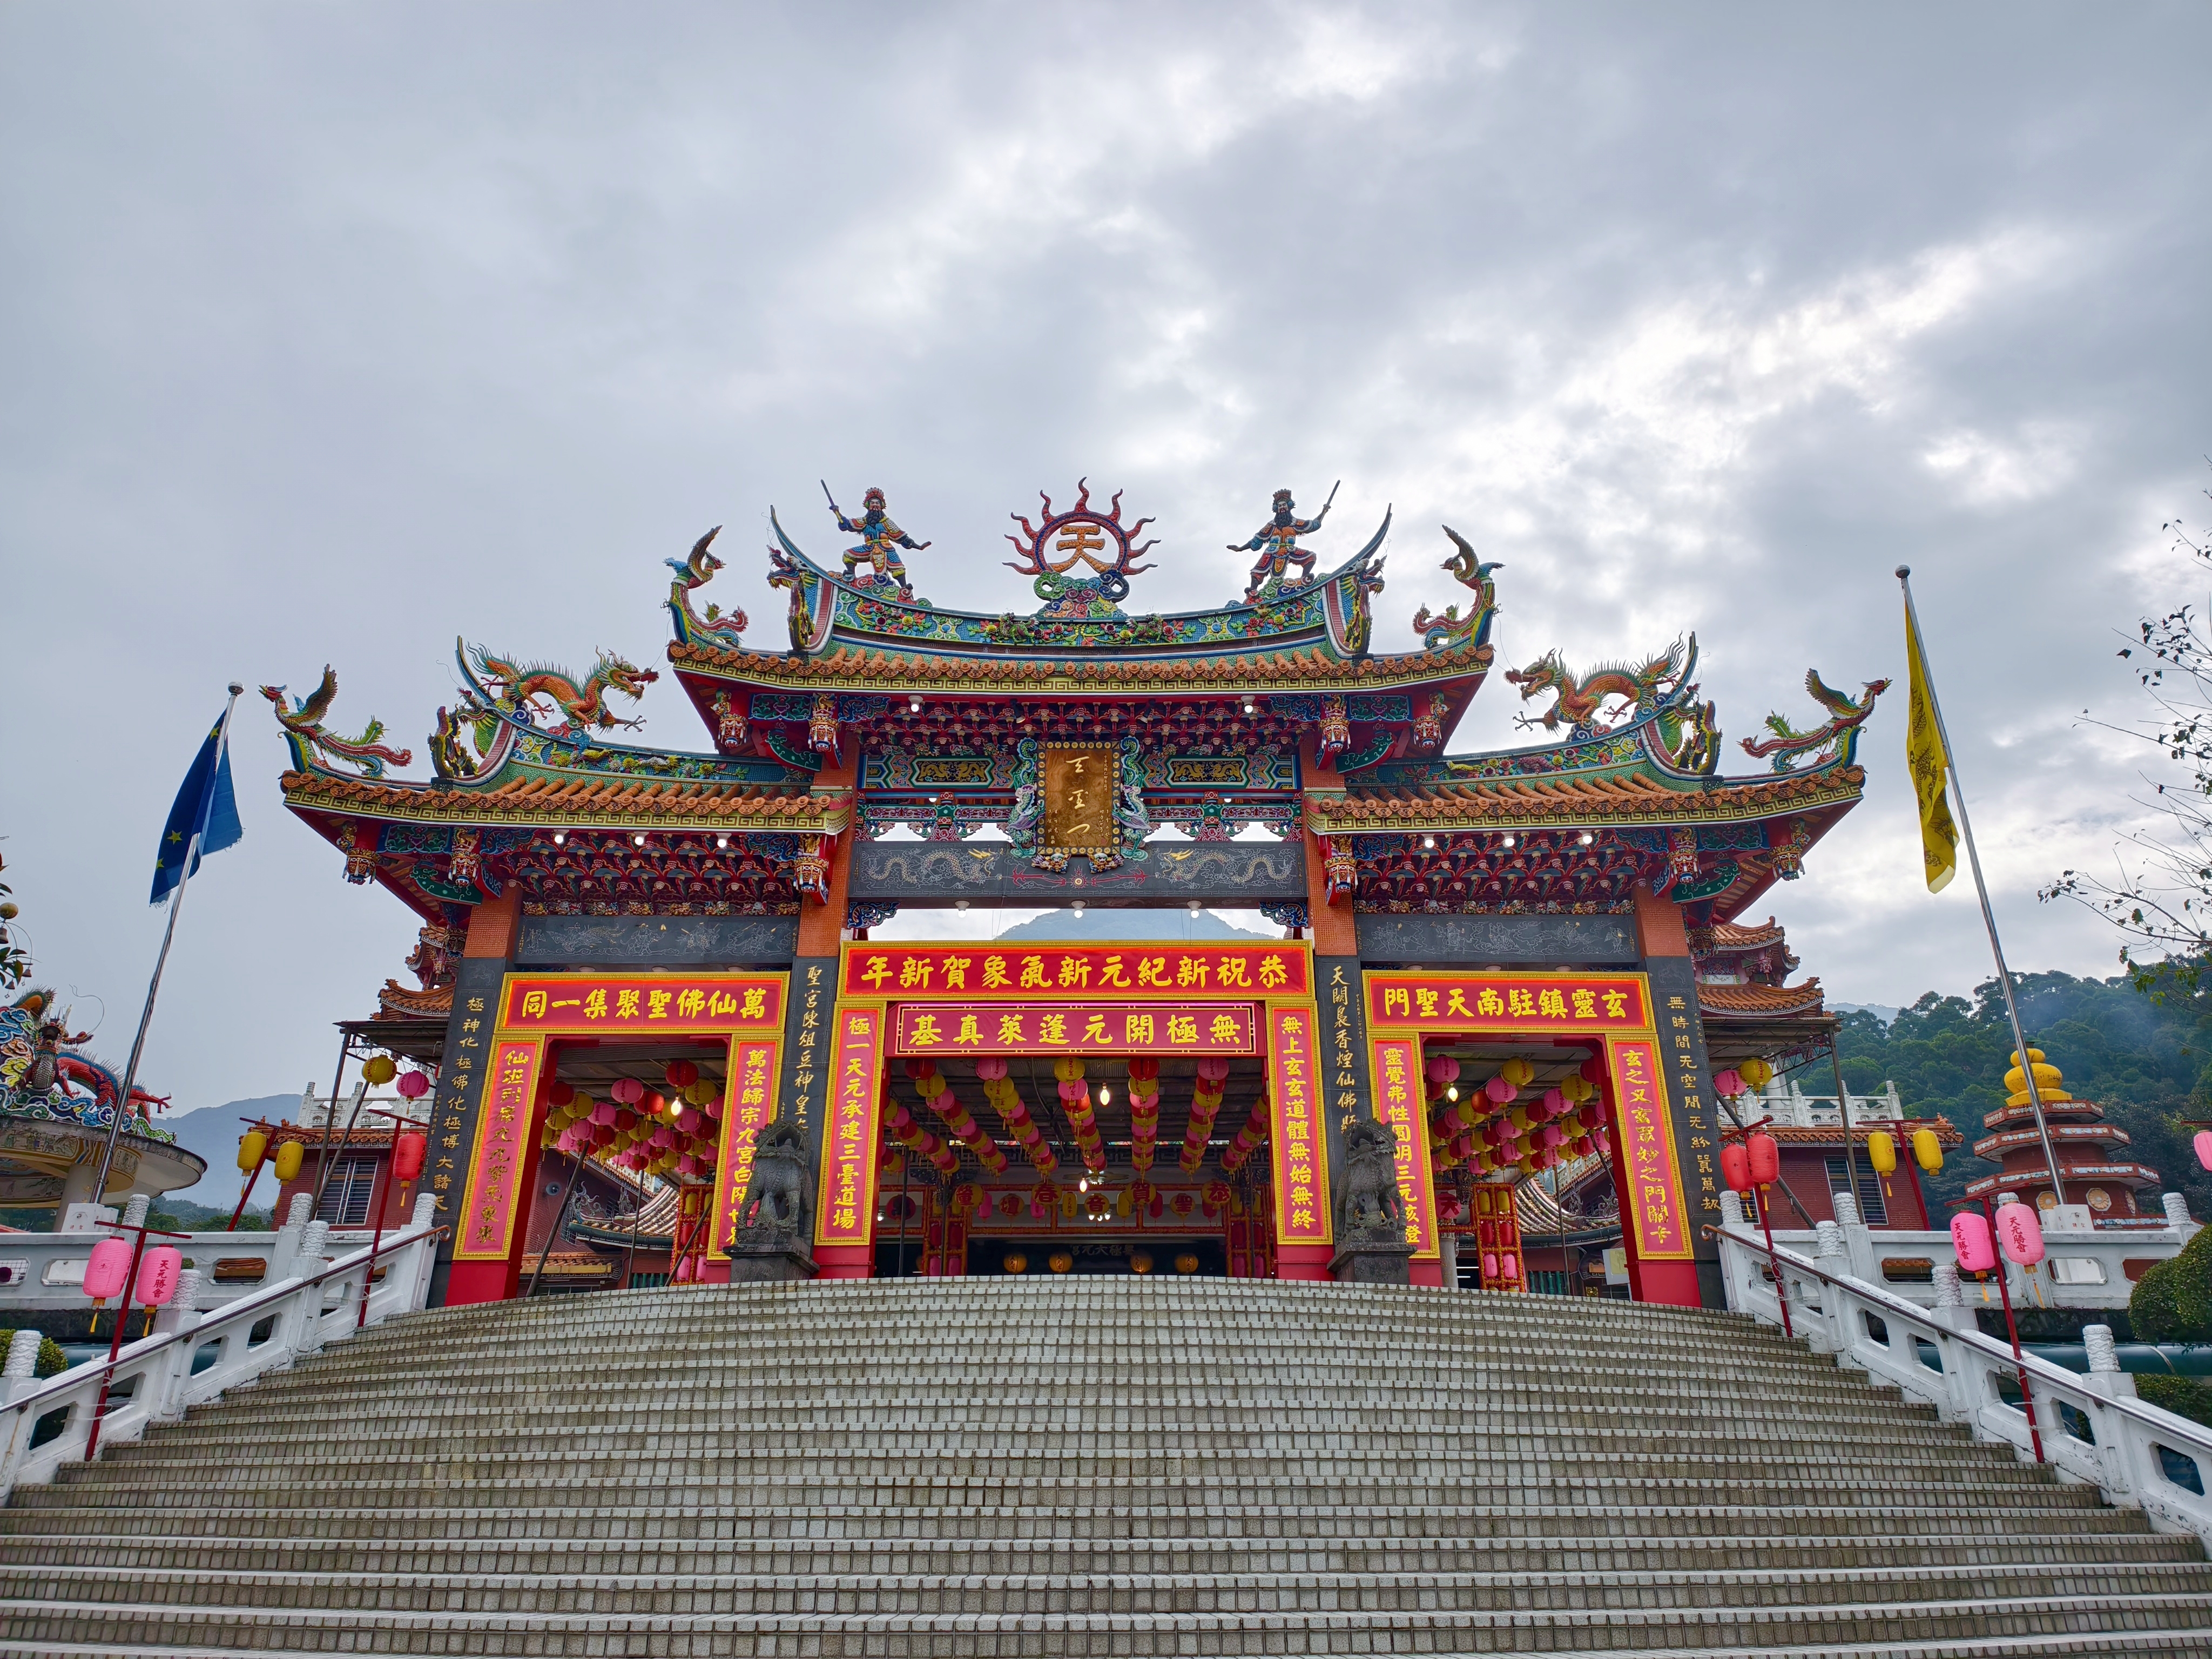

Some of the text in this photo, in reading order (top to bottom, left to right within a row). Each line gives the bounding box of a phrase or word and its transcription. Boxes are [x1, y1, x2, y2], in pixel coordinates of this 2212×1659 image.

[1050, 525, 1114, 573] 天
[861, 955, 1287, 990] 恭祝新紀元新氣象賀新年
[522, 988, 766, 1020] 萬仙佛聖聚集一同
[1385, 988, 1628, 1019] 玄靈鎮駐南天聖門
[909, 1014, 1241, 1046] 無極開元蓬萊真基
[833, 1017, 871, 1229] 極一天元承建三臺道場
[1281, 1016, 1316, 1229] 無上玄玄道體無始無終
[1034, 1182, 1059, 1203] 春
[1087, 1195, 1105, 1212] 音
[1131, 1182, 1150, 1203] 賀
[1208, 1182, 1230, 1202] 恭
[1438, 1197, 1459, 1216] 天
[1954, 1222, 1971, 1260] 天元勝會
[2009, 1216, 2028, 1252] 天元勝會
[152, 1260, 170, 1298] 天元勝會
